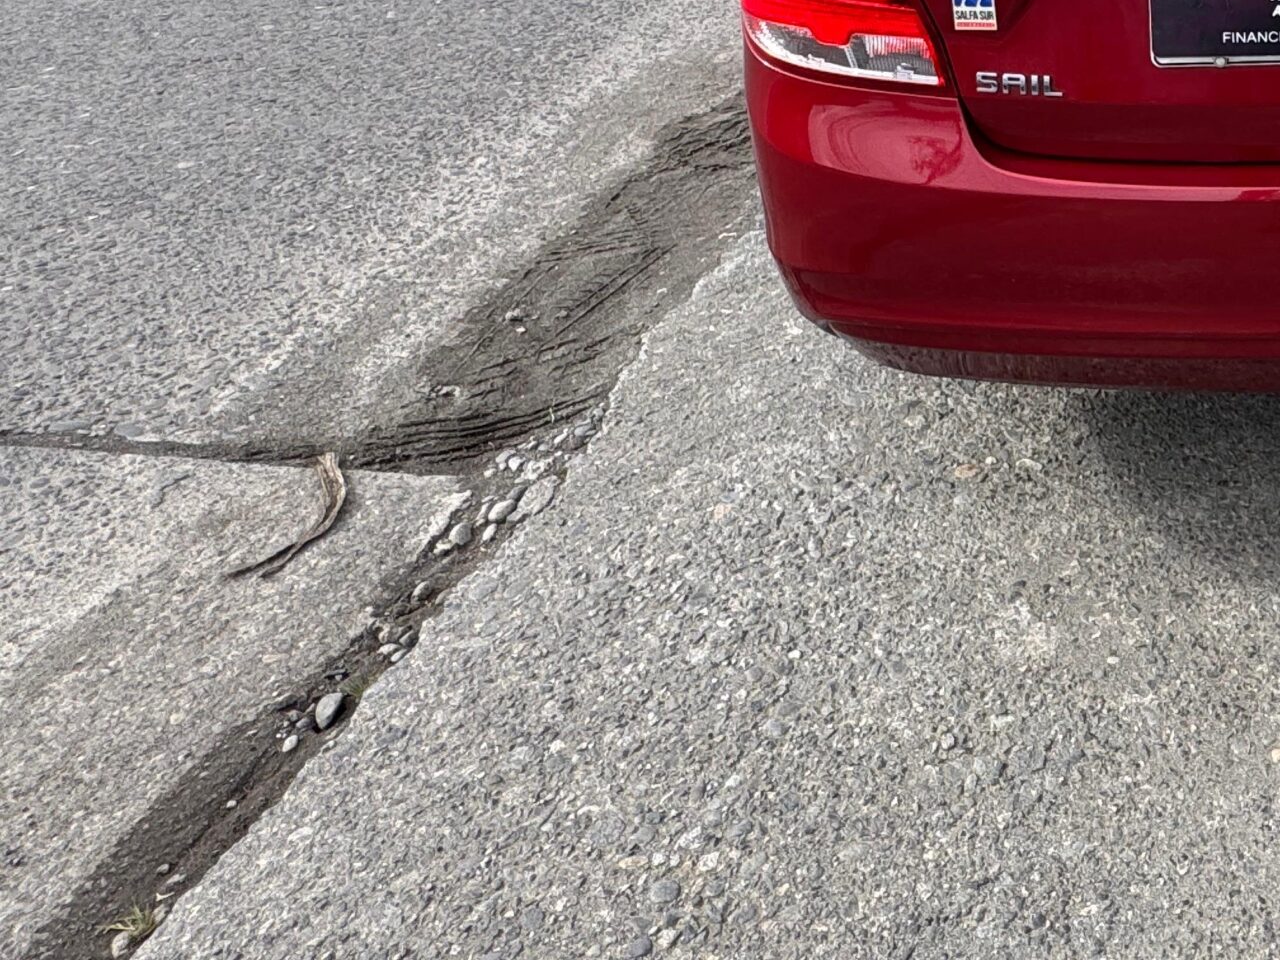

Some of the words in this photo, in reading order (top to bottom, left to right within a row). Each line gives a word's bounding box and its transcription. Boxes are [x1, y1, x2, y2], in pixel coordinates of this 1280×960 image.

[955, 10, 979, 20] SALFA
[979, 10, 995, 20] SUR
[975, 71, 1064, 97] SAIL
